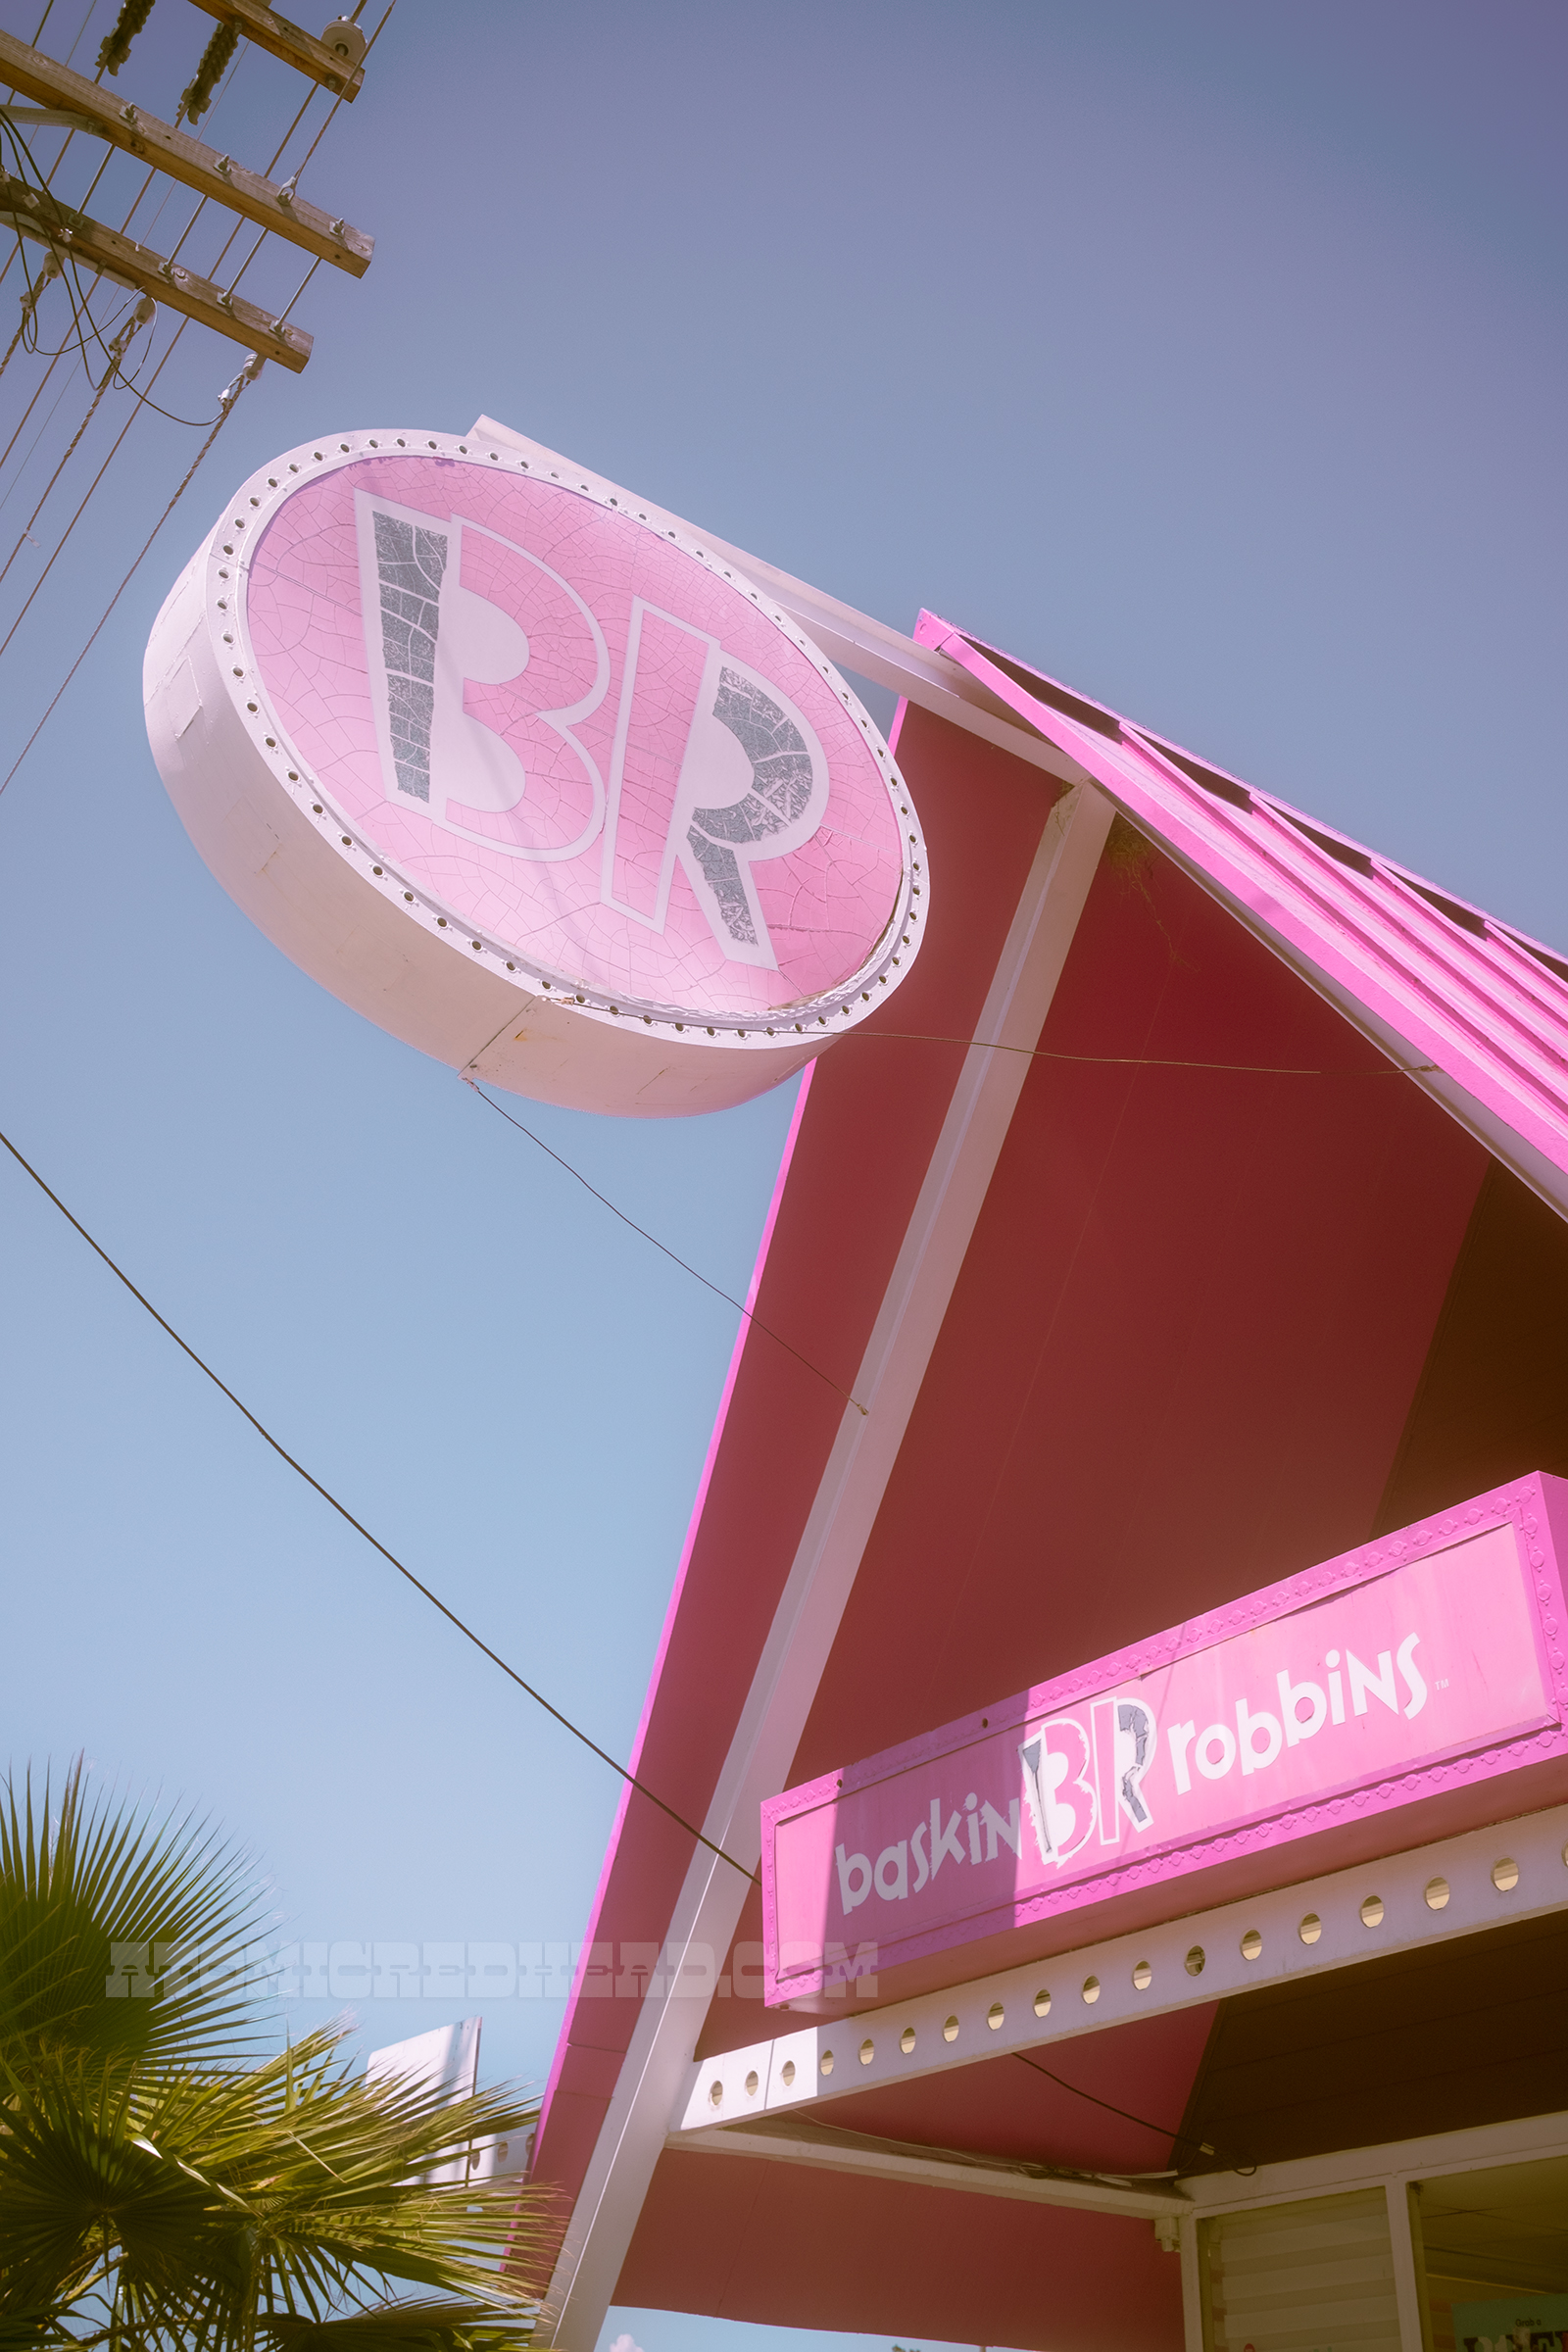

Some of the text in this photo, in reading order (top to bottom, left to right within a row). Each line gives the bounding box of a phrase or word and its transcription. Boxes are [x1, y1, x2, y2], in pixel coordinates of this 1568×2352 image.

[354, 488, 830, 971] BR
[1016, 1696, 1158, 1869] BR
[1515, 2318, 1535, 2328] Grab
